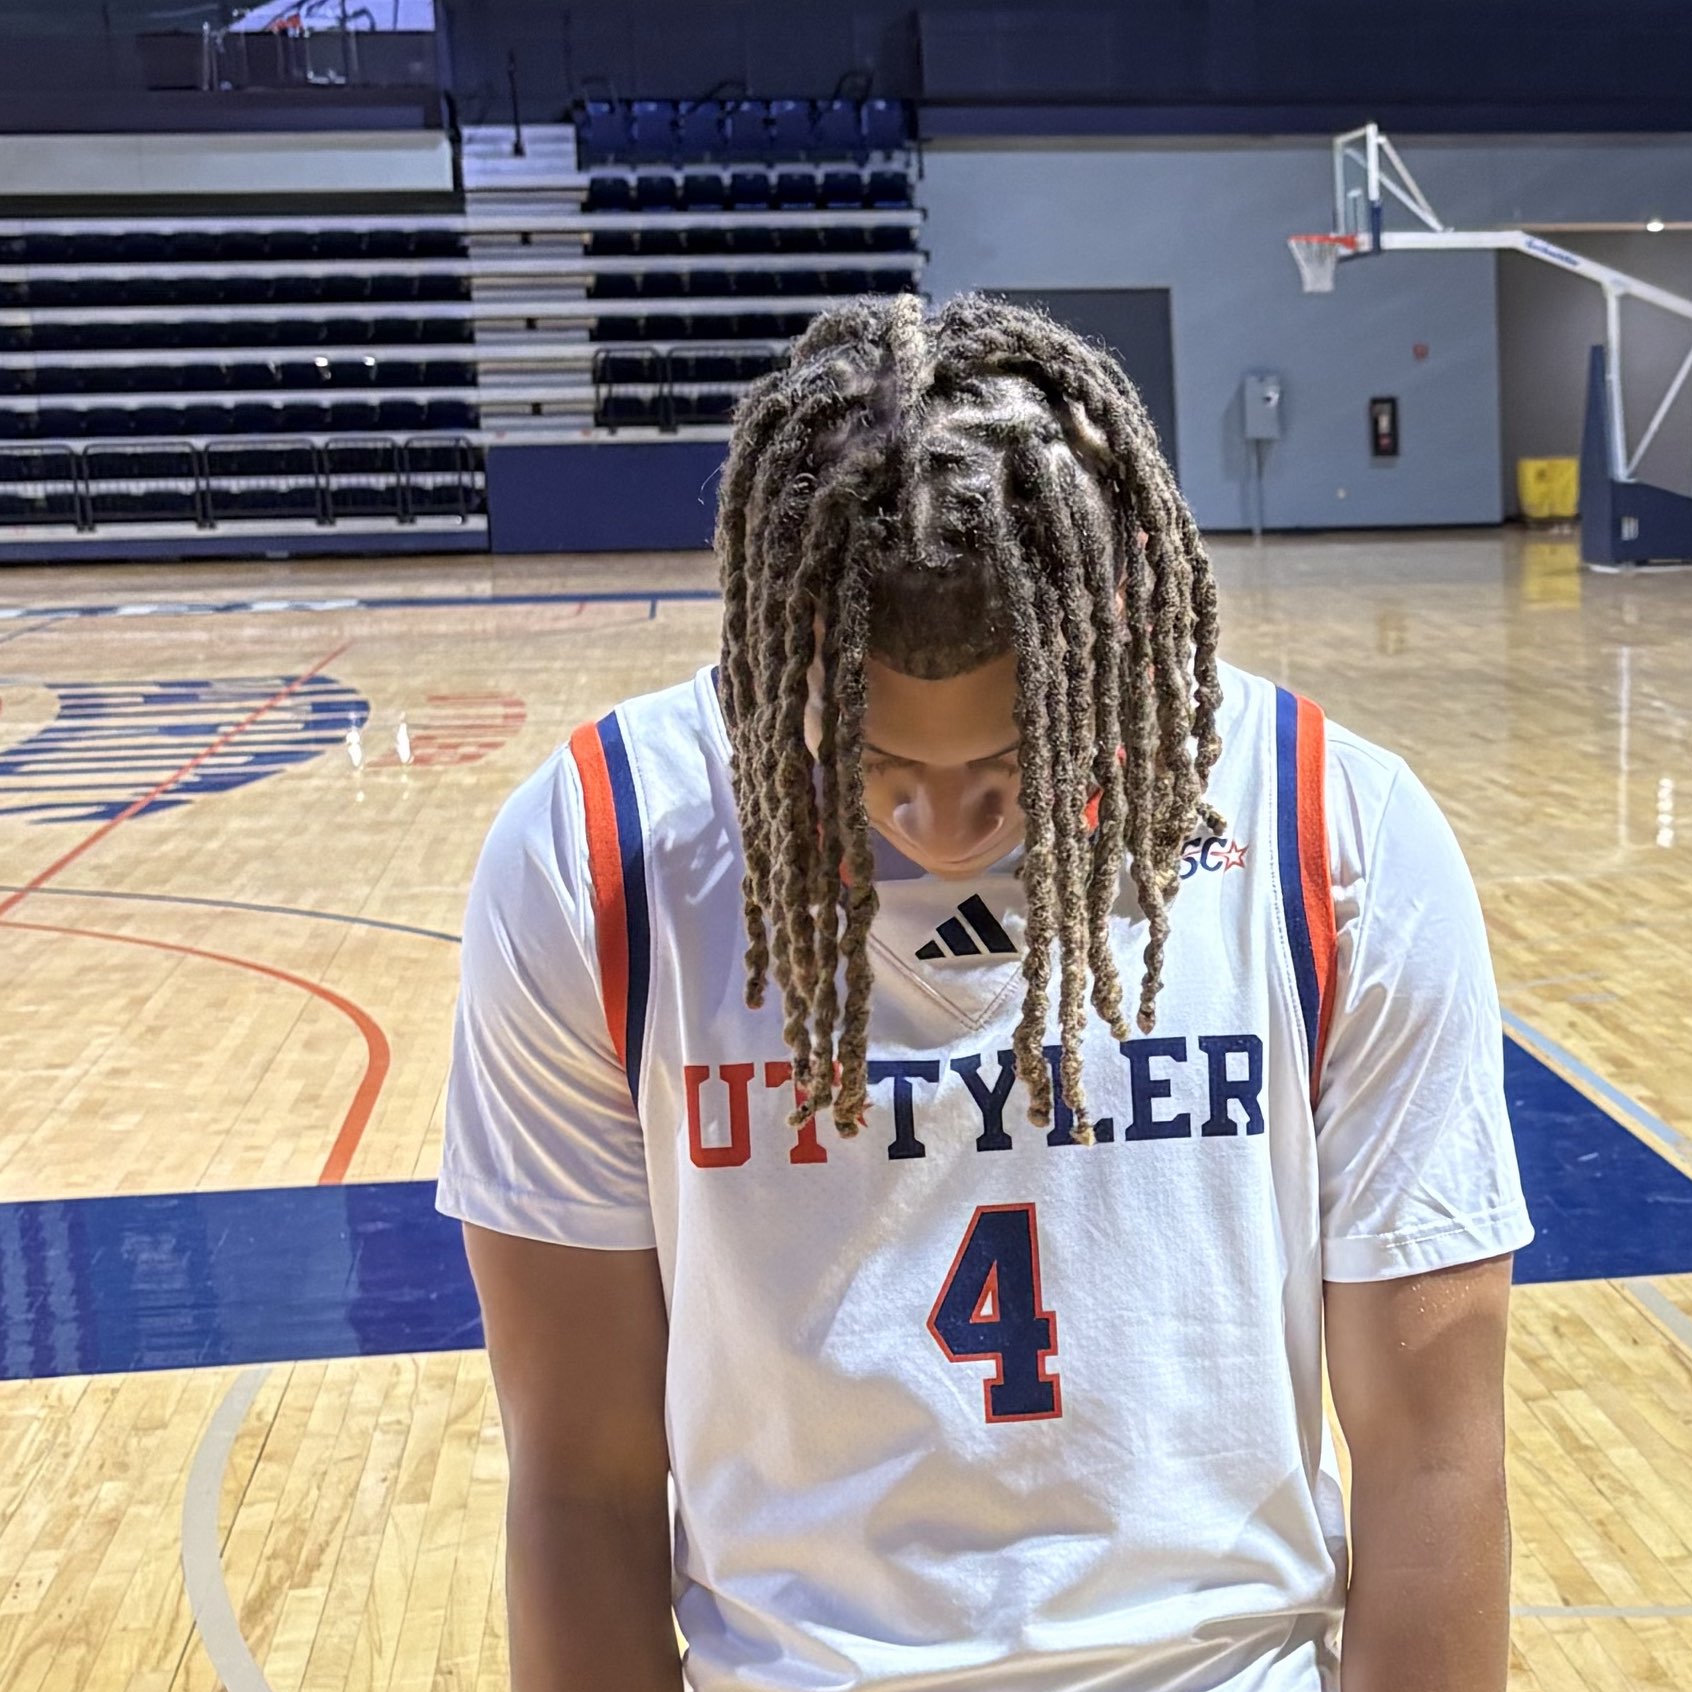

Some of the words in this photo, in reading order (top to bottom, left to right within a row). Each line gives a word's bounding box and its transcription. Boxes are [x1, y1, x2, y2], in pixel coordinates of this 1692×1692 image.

[1179, 836, 1228, 879] SC
[866, 1034, 1265, 1161] TYLER
[926, 1202, 1063, 1424] 4
